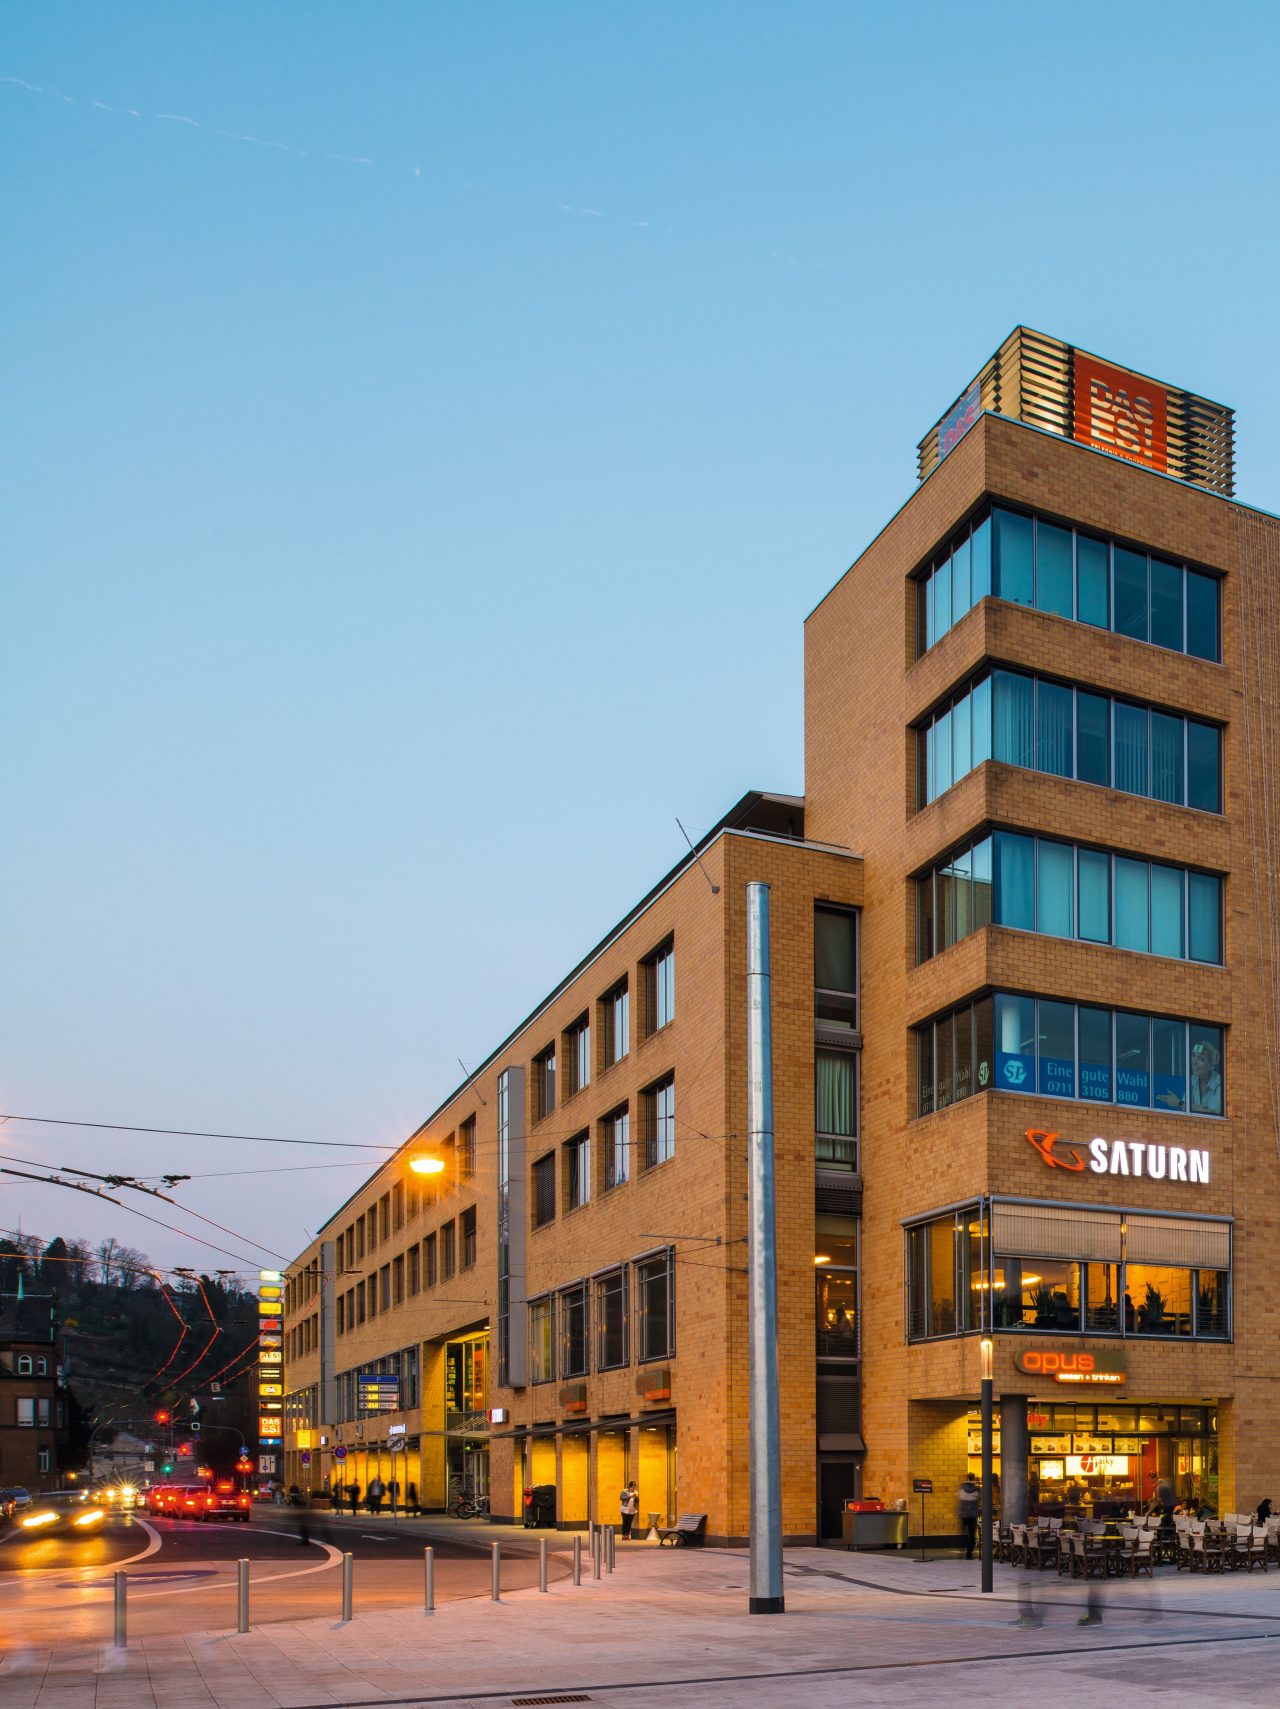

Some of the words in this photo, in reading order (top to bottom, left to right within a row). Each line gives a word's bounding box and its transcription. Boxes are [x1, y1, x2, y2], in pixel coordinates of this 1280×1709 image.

[1091, 378, 1153, 425] DAS
[1091, 408, 1153, 459] ES!
[1047, 1062, 1073, 1078] Eine
[1082, 1068, 1109, 1084] gute
[1117, 1072, 1147, 1088] Wahl
[1047, 1081, 1072, 1094] 0711
[1082, 1085, 1109, 1098] 3105
[1118, 1090, 1138, 1102] 880
[1088, 1138, 1210, 1183] SATURN
[1023, 1352, 1095, 1375] opus
